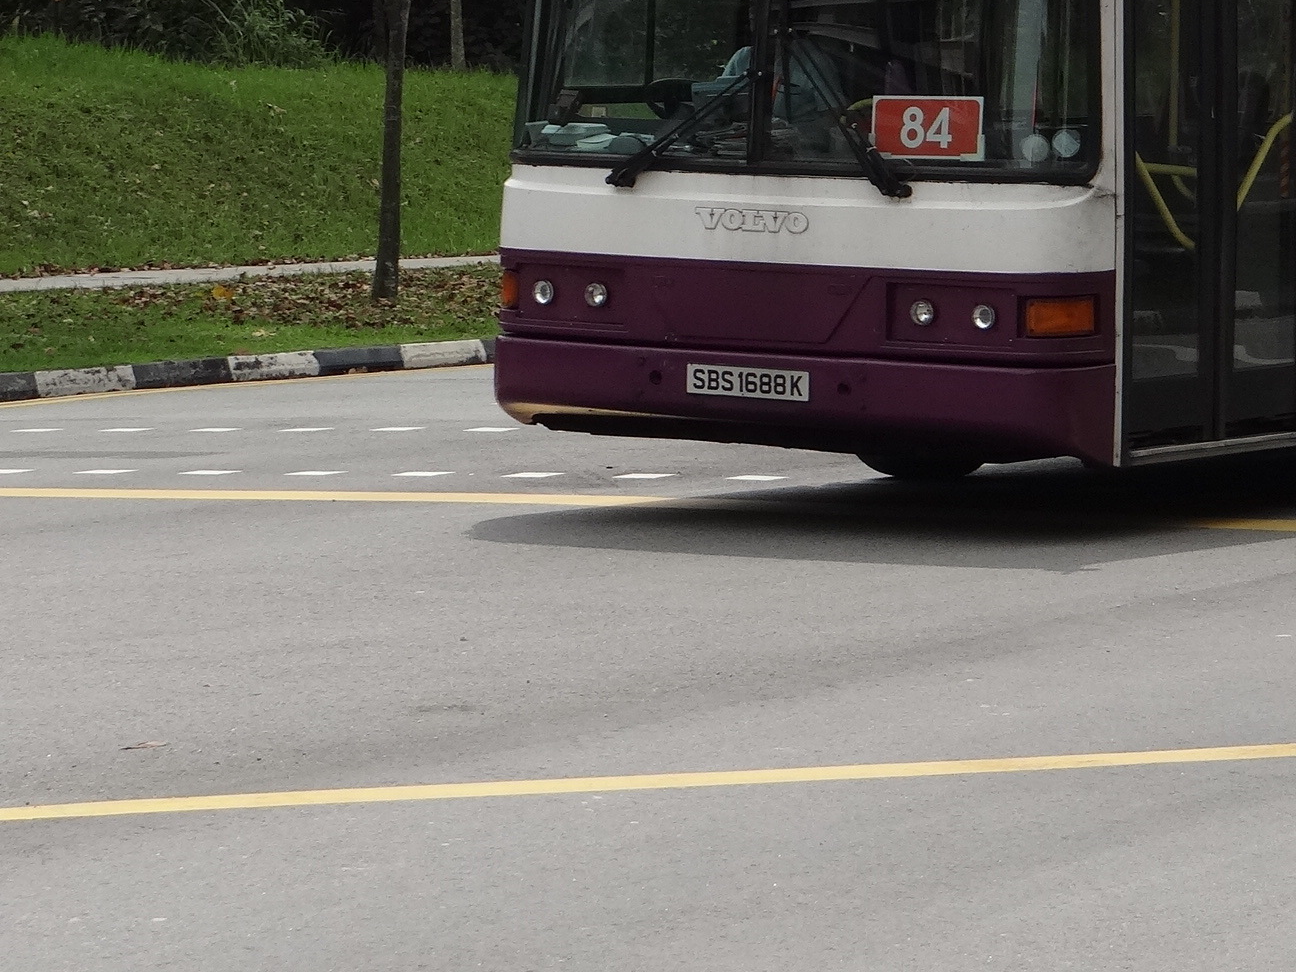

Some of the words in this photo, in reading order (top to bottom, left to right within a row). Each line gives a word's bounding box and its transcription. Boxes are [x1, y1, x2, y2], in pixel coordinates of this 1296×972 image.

[900, 106, 953, 149] 84
[694, 206, 810, 235] VOLVO
[692, 368, 803, 397] SBS1688K
